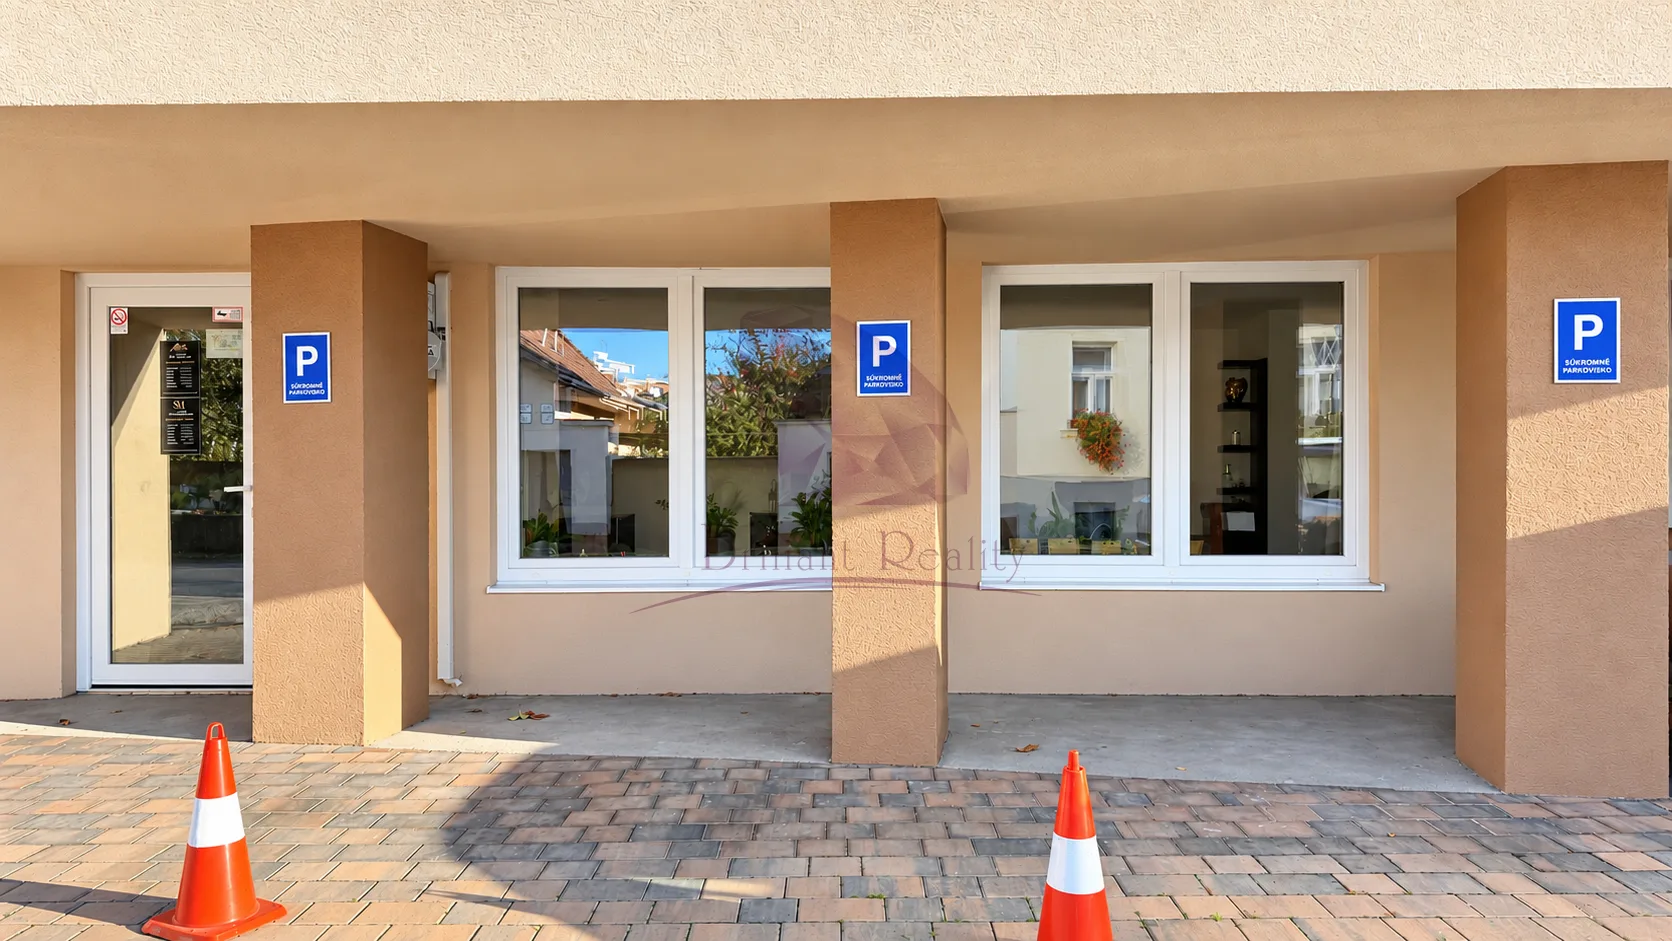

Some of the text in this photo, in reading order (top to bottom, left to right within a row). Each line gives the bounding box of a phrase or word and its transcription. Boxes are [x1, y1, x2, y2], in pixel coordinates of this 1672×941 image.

[1574, 314, 1604, 351] P
[296, 345, 319, 377] P
[872, 335, 897, 367] P
[1564, 358, 1610, 366] SÚKROMNÉ
